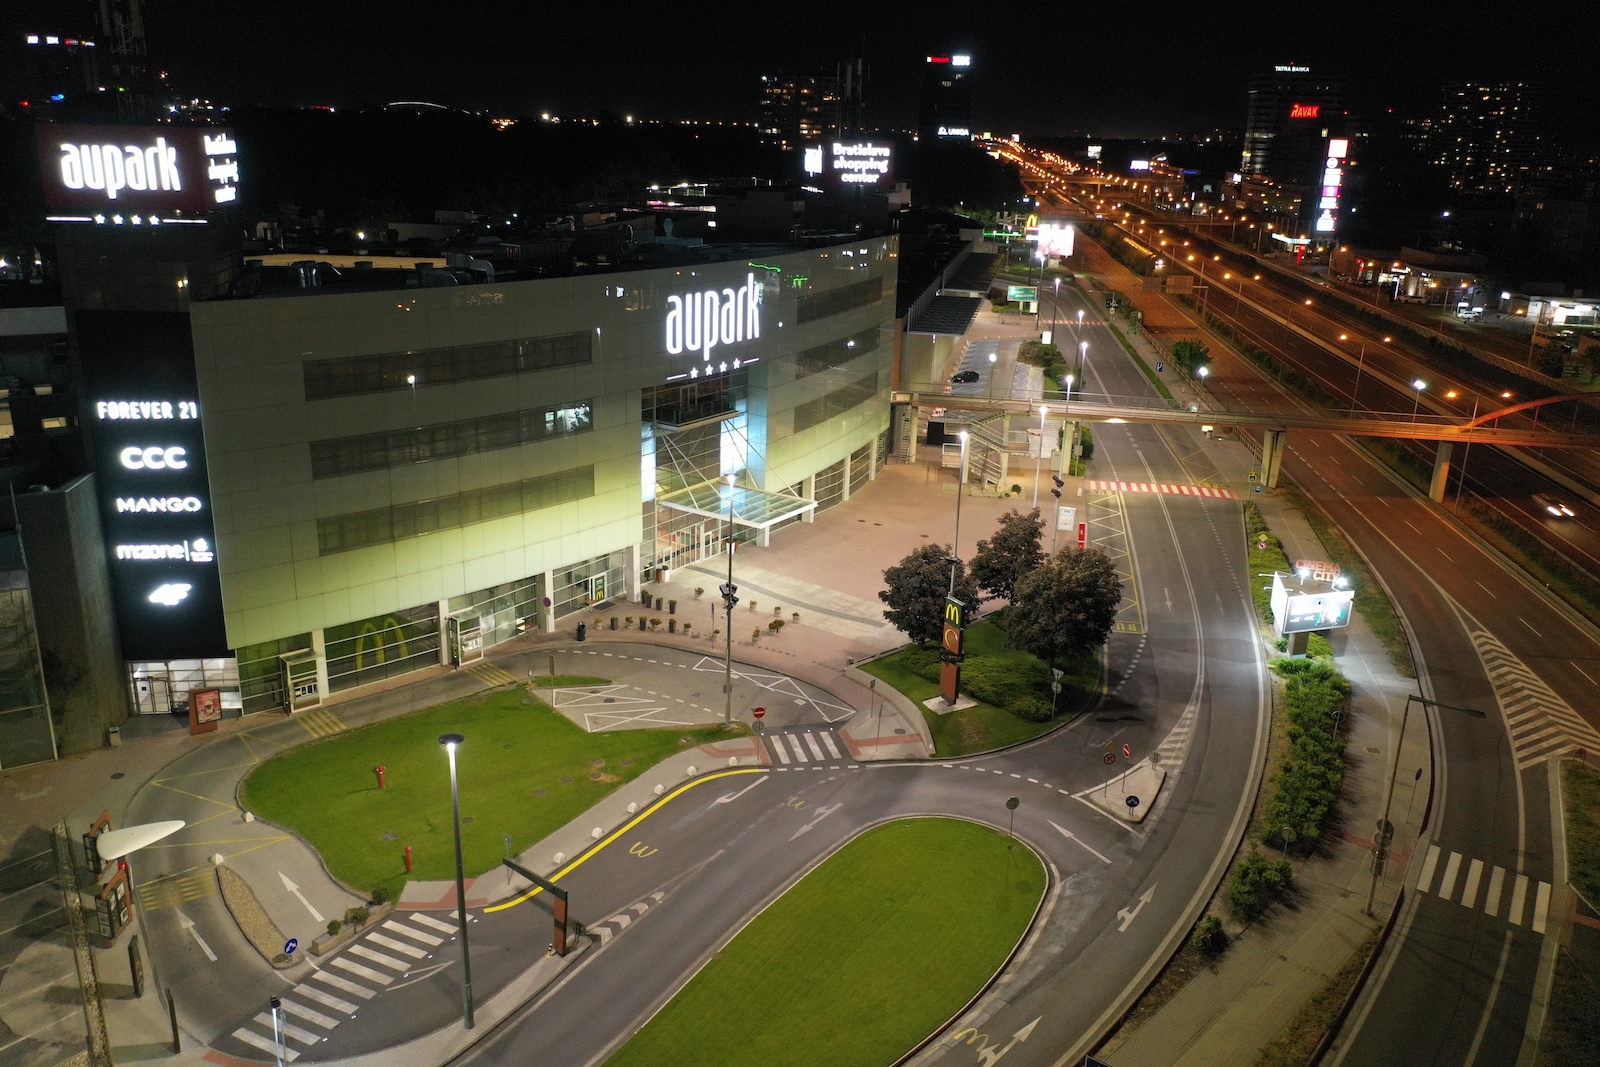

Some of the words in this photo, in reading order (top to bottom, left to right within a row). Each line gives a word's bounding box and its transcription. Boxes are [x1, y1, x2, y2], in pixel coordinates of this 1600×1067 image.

[1291, 104, 1319, 118] RAVAK
[832, 142, 891, 157] Bratislava
[60, 136, 182, 199] aupark
[833, 156, 889, 173] shopping
[841, 172, 880, 183] center
[665, 272, 761, 361] aupark
[97, 401, 174, 420] FOREVER
[178, 401, 198, 420] 21
[119, 446, 188, 470] CCC
[116, 496, 202, 513] MANGO
[1295, 559, 1342, 573] CINEMA
[1312, 570, 1341, 582] CITY
